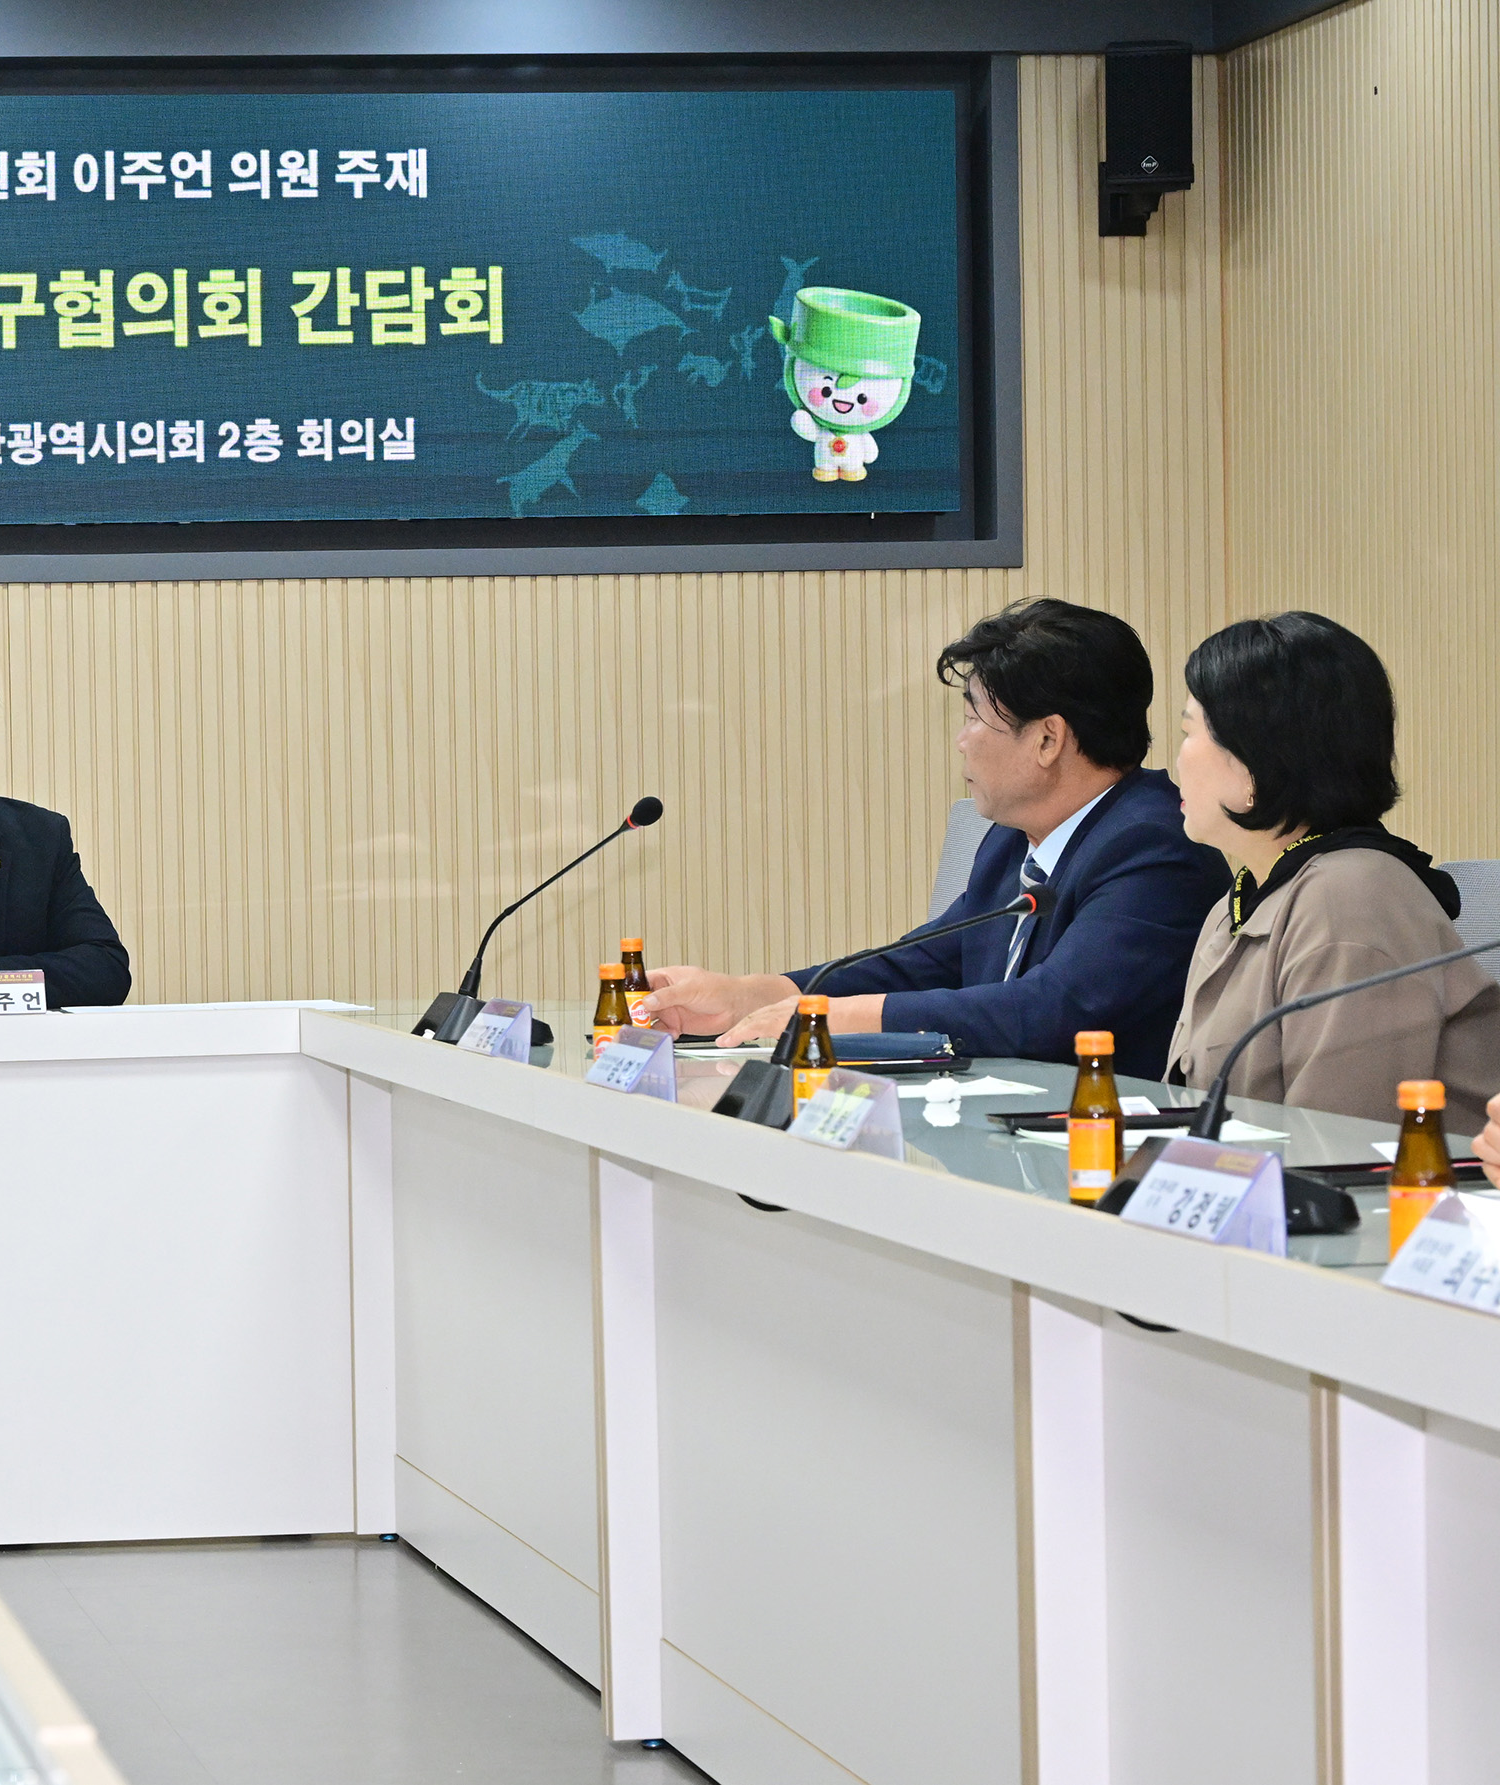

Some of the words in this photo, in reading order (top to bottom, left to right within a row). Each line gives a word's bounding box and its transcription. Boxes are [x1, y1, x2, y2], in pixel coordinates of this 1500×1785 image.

[73, 149, 213, 201] 이주언
[228, 149, 319, 200] 의원
[334, 148, 428, 199] 주재
[290, 265, 503, 345] 간담회
[218, 418, 284, 463] 2층
[296, 417, 416, 462] 회의실
